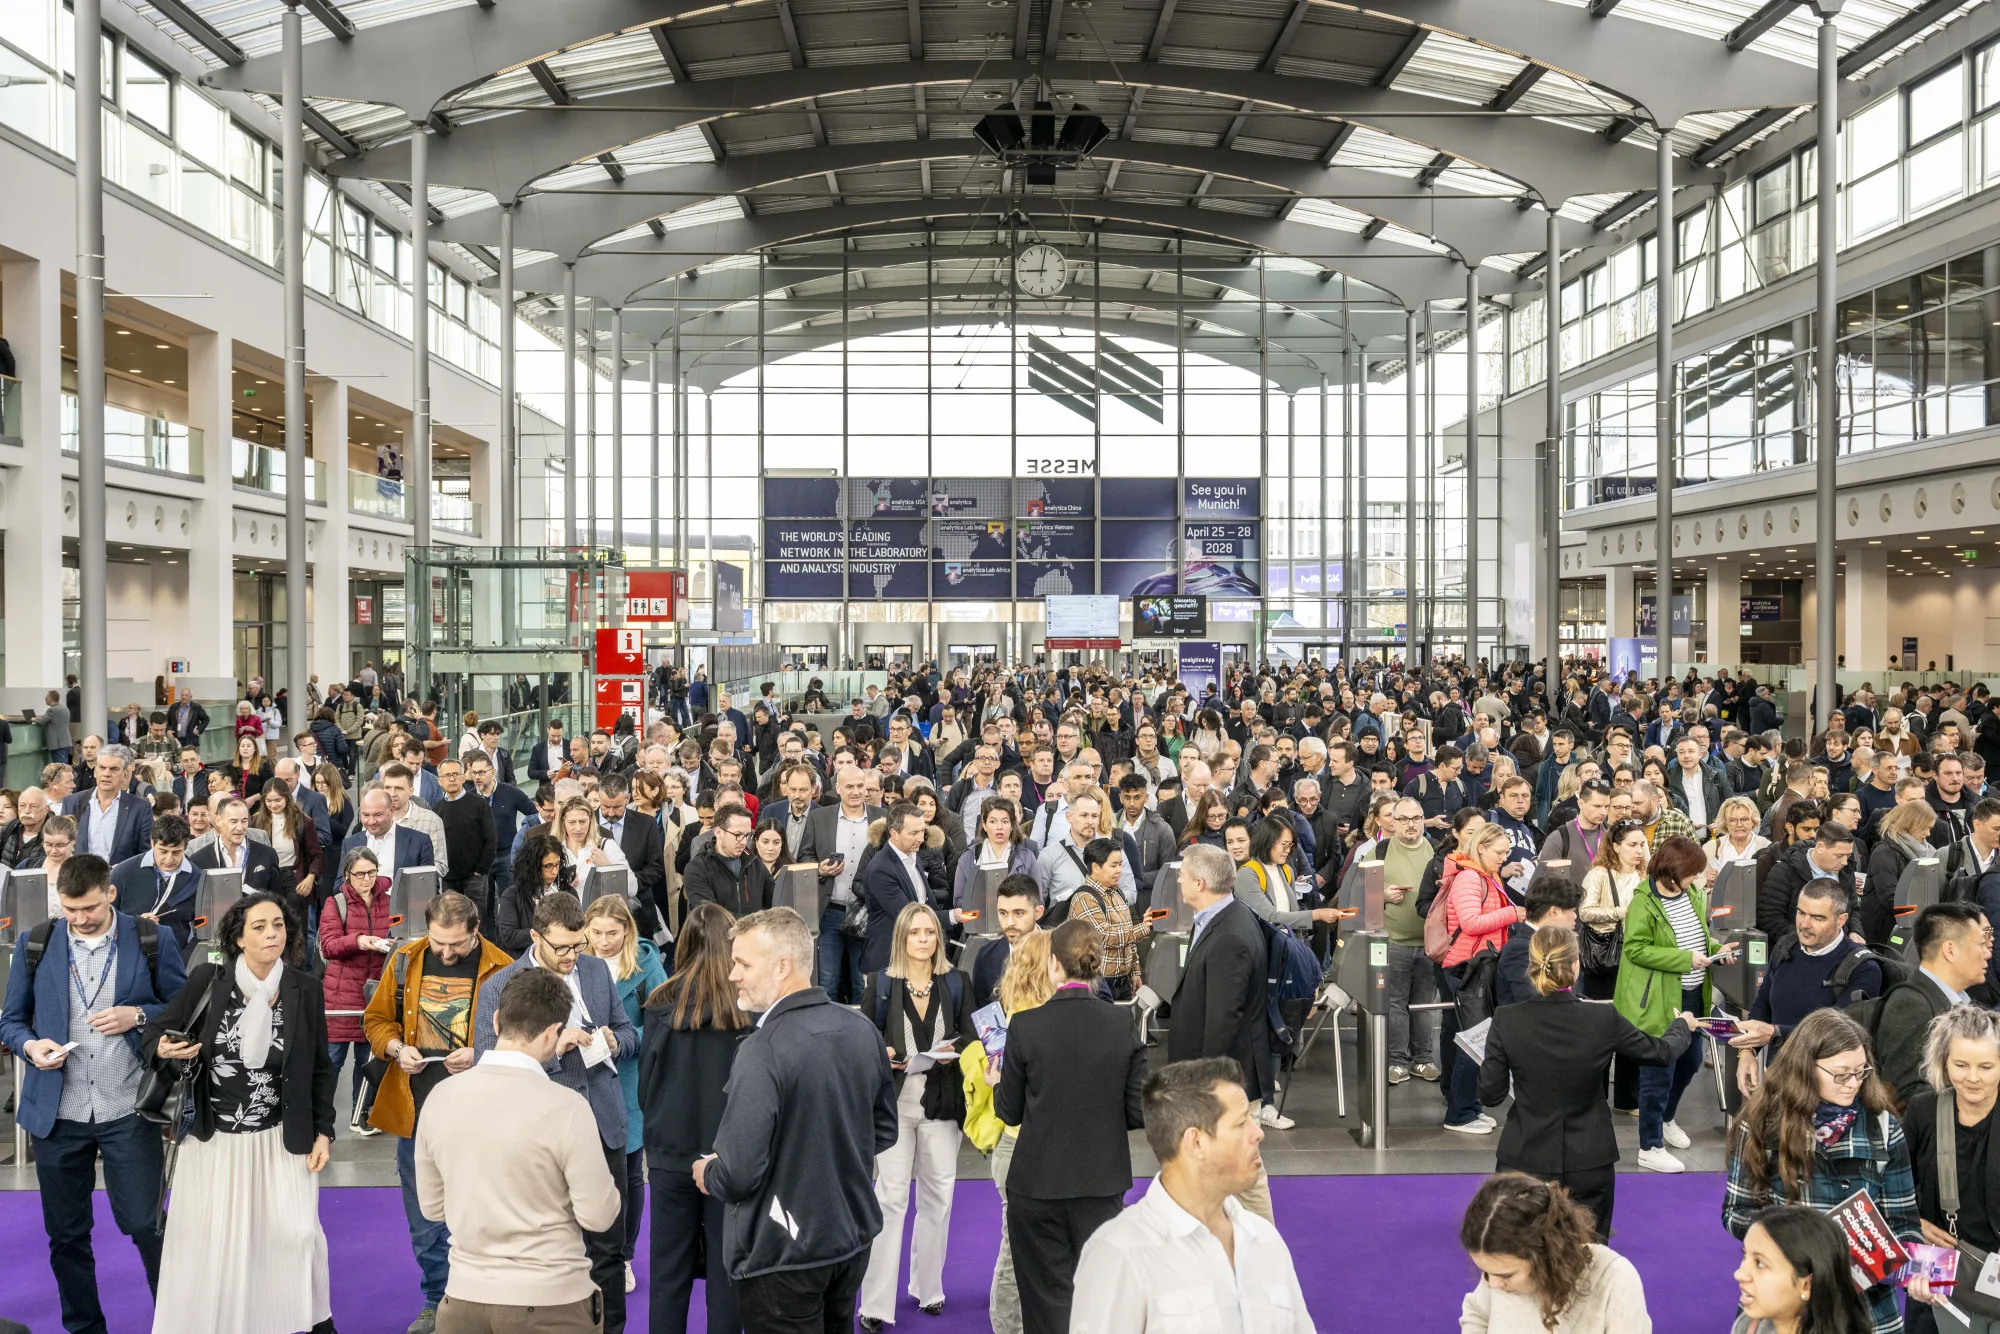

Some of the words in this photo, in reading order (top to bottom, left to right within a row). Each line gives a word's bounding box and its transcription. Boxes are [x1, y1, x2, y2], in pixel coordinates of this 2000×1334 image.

[1192, 484, 1211, 495] See
[1214, 486, 1234, 498] you
[1237, 484, 1246, 495] in
[1198, 498, 1240, 510] Munich!
[780, 532, 798, 541] THE
[801, 532, 843, 541] WORLD'S
[850, 532, 890, 541] LEADING
[1187, 526, 1209, 539] April
[1212, 526, 1224, 537] 25
[1238, 526, 1251, 537] 28
[781, 548, 830, 557] NETWORK
[834, 548, 843, 557] IN
[850, 548, 867, 557] THE
[869, 548, 927, 557] LABORATORY
[1206, 543, 1233, 553] 2028
[780, 564, 800, 573] AND
[850, 564, 896, 573] INDUSTRY
[1843, 1208, 1872, 1252] science.
[1854, 1200, 1896, 1259] Supporting
